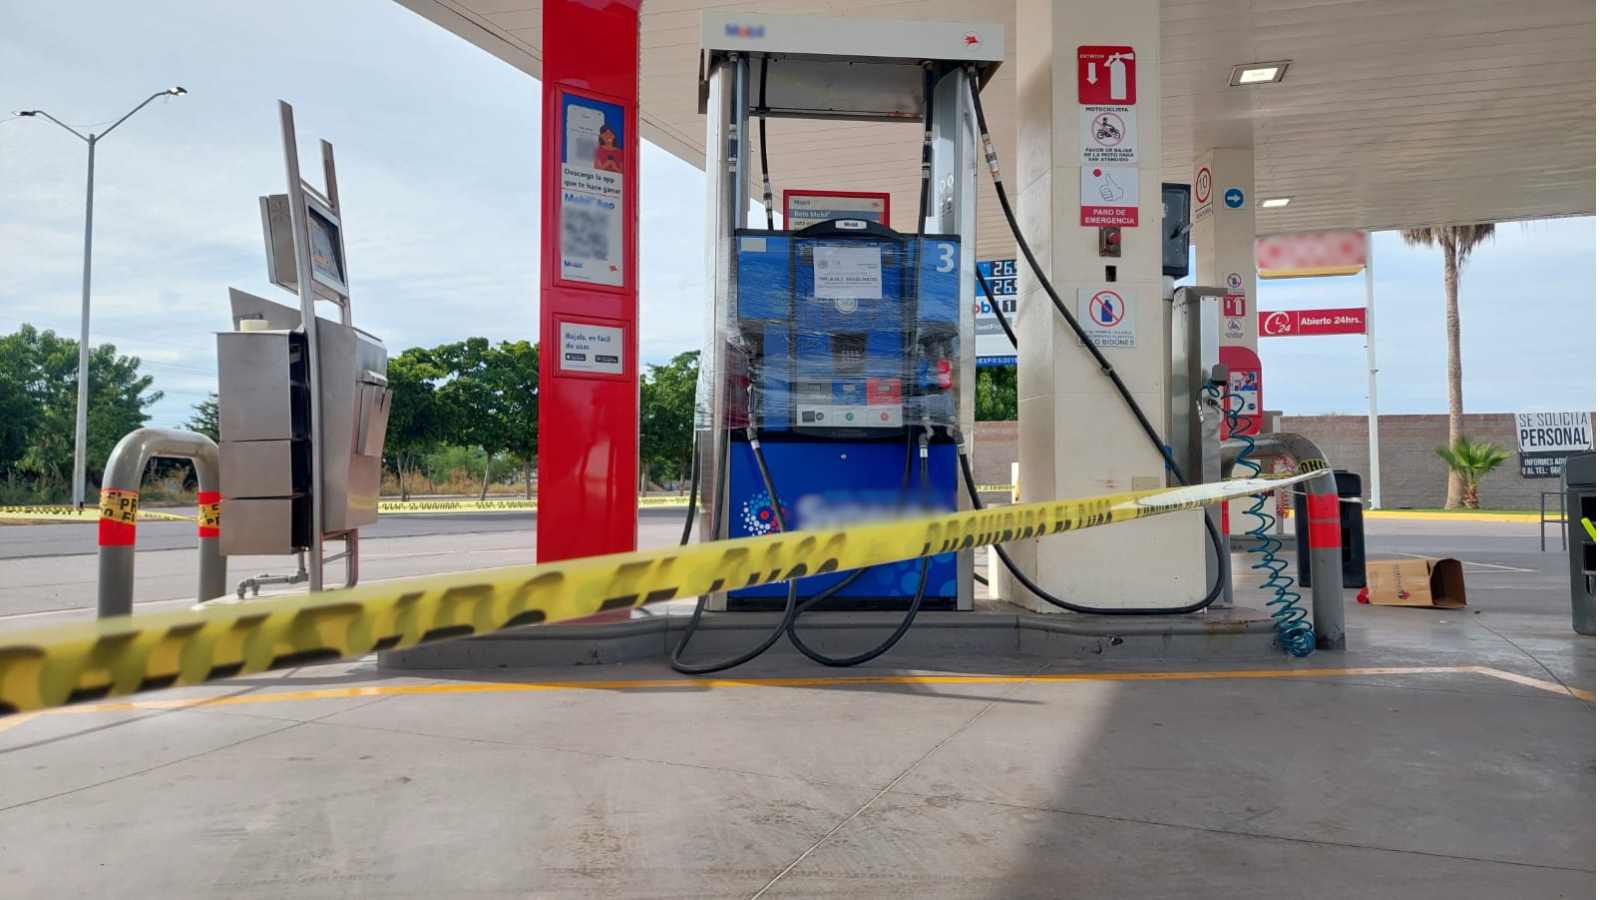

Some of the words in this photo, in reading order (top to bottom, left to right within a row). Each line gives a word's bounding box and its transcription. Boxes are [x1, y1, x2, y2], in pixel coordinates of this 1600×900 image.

[564, 168, 595, 181] Descarga
[1093, 208, 1114, 216] PARO
[1085, 216, 1135, 224] EMERGENCIA
[936, 243, 954, 272] 3
[1301, 316, 1332, 326] Abierto
[1333, 315, 1362, 325] 24hrs.
[1278, 324, 1291, 333] 24
[1519, 413, 1533, 427] SE
[1536, 412, 1587, 426] SOLICITA
[1521, 427, 1589, 446] PERSONAL
[1527, 467, 1535, 475] AL
[921, 507, 1048, 556] PROHIBIDO
